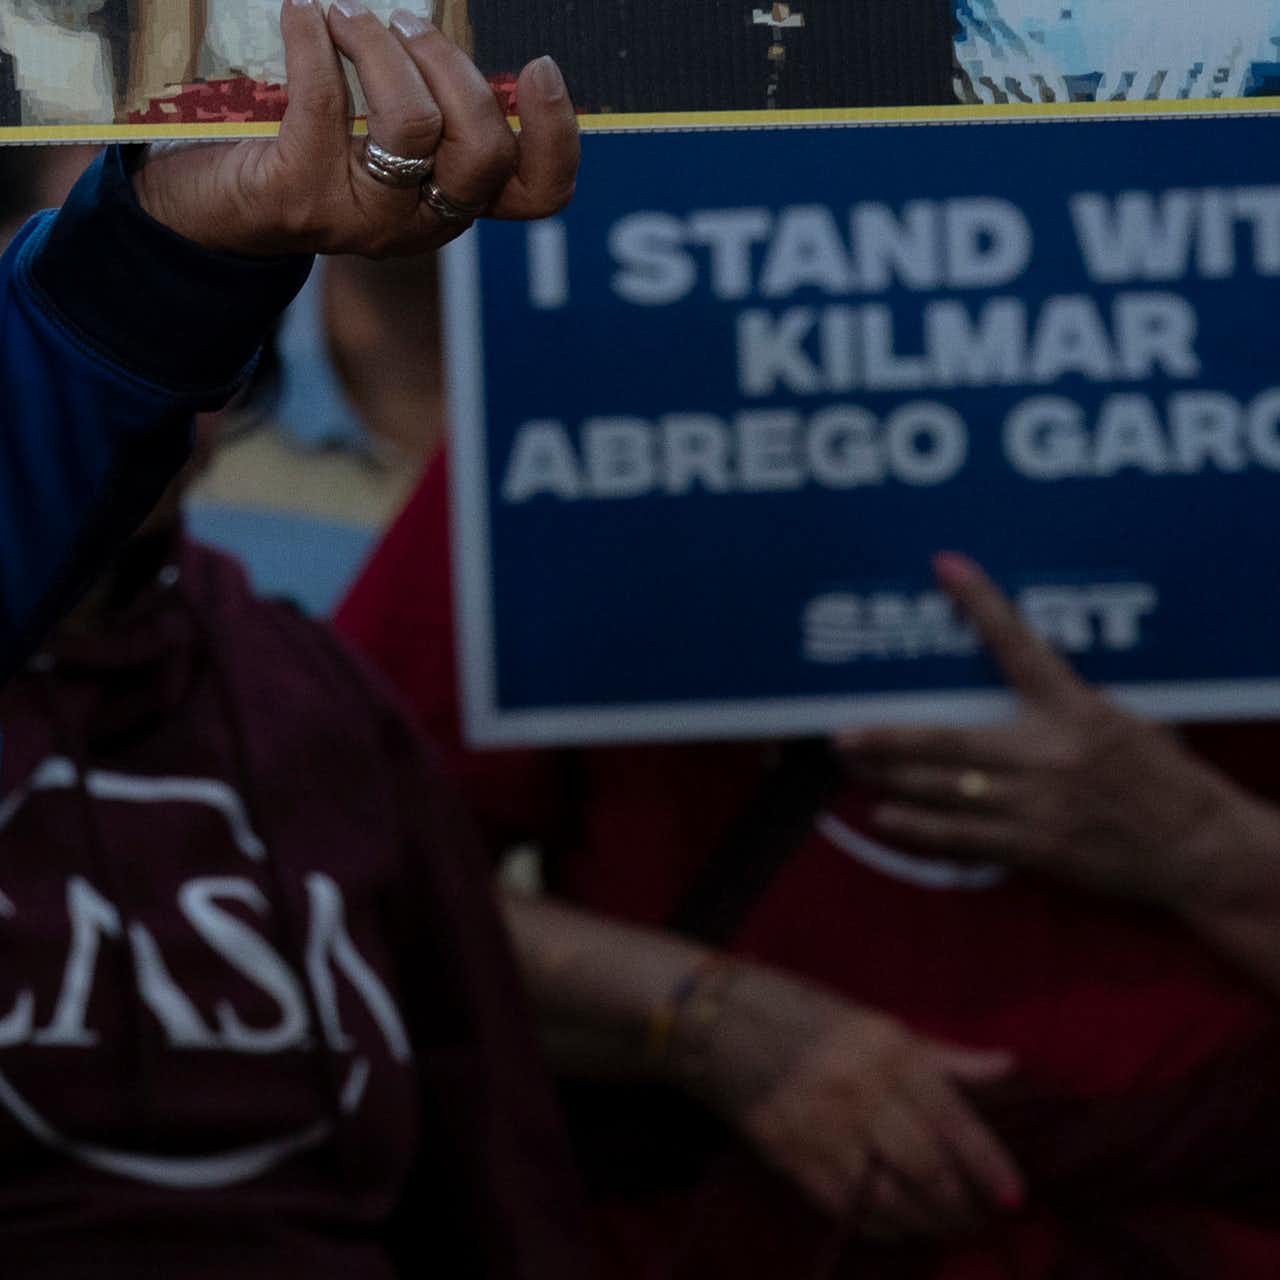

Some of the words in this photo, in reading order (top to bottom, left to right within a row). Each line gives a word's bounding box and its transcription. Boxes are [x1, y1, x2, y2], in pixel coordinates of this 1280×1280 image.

[526, 220, 568, 308] I
[608, 195, 1034, 307] STAND
[733, 289, 1202, 396] KILMAR
[502, 400, 968, 504] ABREGO
[800, 582, 1157, 663] SMRT
